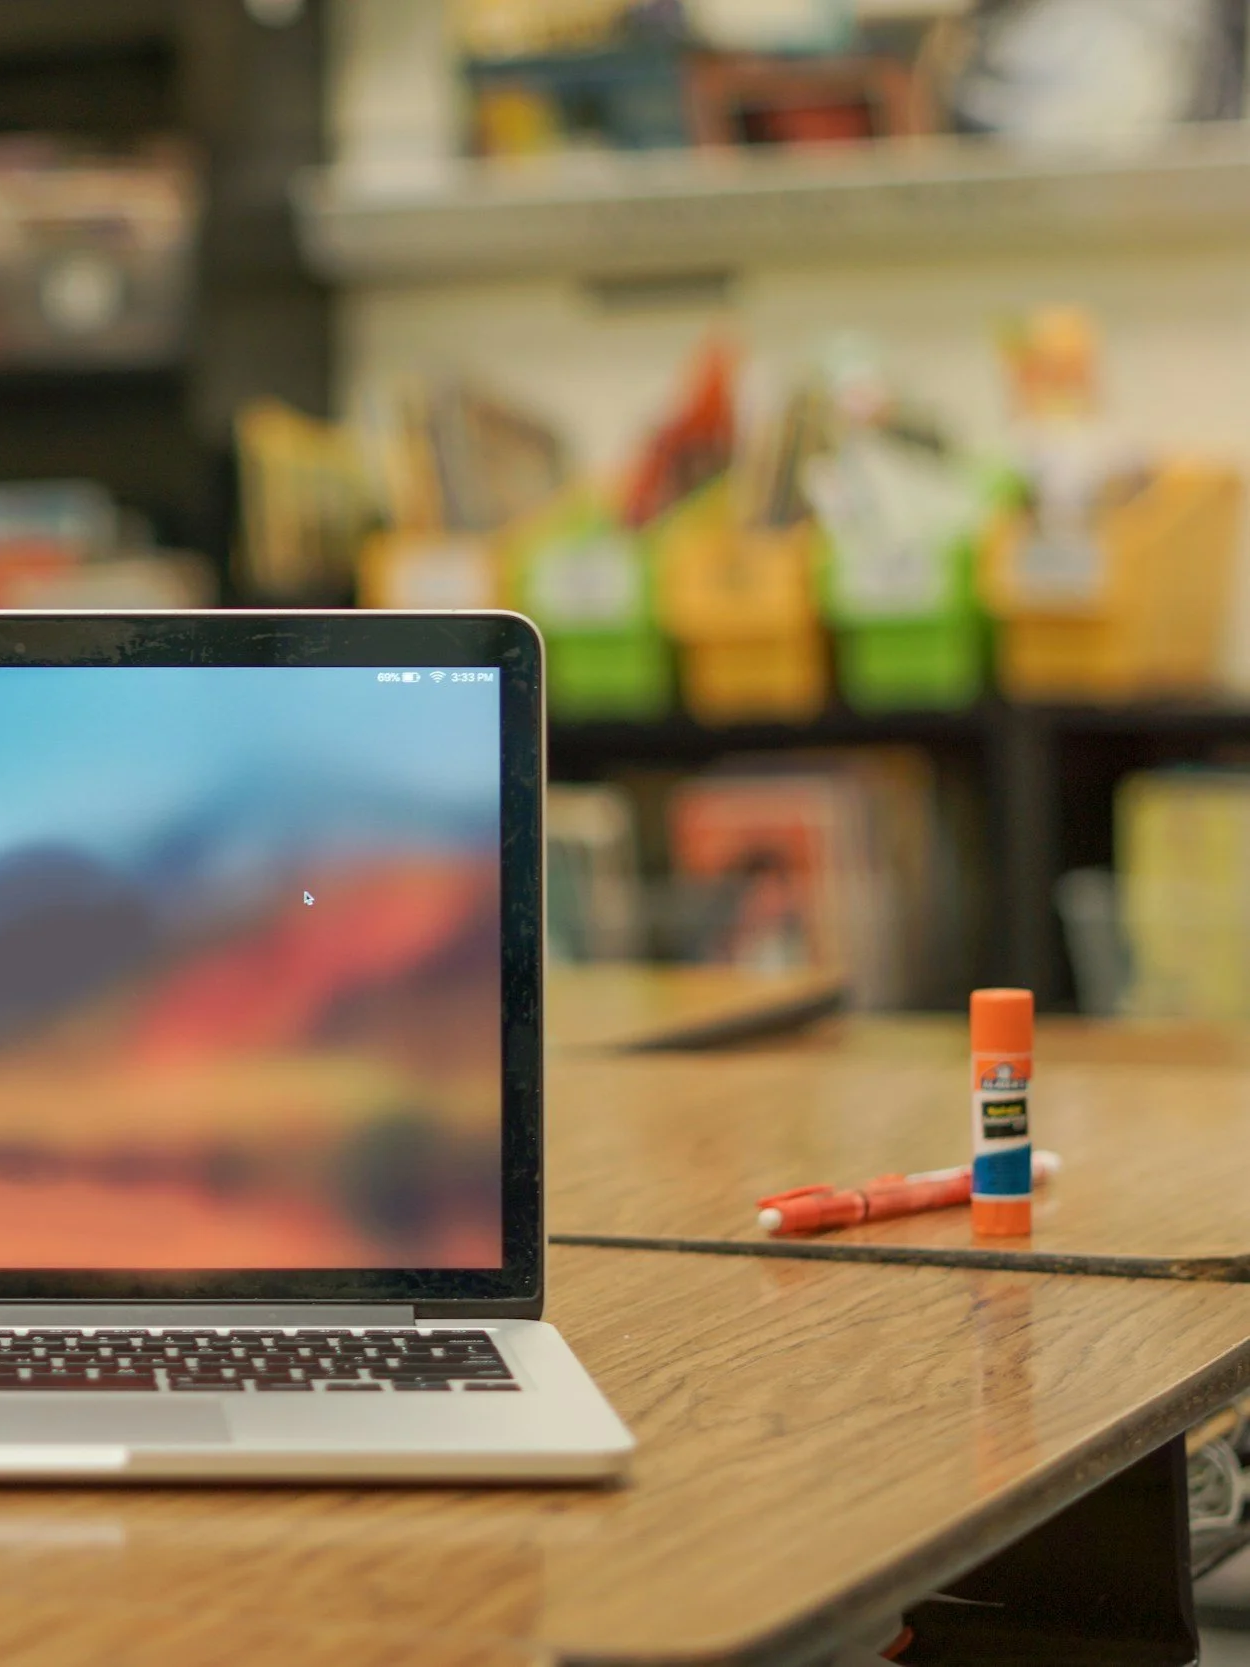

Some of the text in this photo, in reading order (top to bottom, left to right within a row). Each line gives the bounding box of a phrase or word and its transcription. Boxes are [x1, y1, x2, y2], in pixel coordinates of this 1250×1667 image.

[377, 672, 494, 682] 69% 3:33 PM
